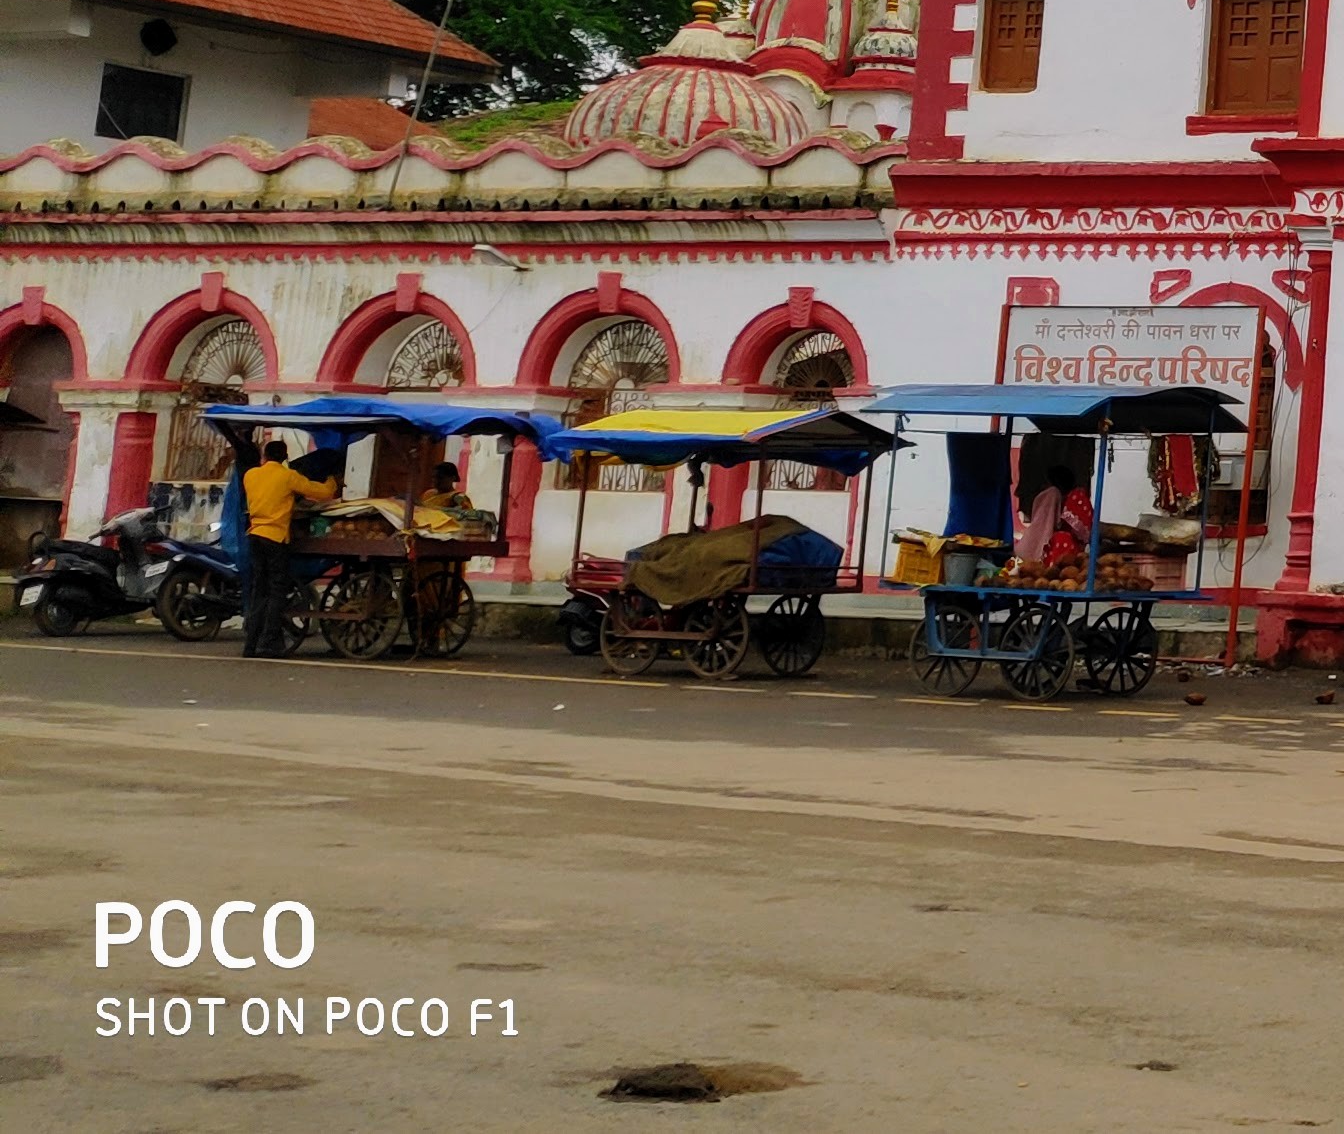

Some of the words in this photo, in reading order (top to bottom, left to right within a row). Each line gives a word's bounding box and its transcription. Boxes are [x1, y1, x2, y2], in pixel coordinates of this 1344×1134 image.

[1056, 319, 1116, 341] दन्तेश्वरी
[1121, 319, 1141, 340] की
[1146, 324, 1184, 341] पावन
[1189, 324, 1216, 341] धरा
[1221, 324, 1242, 341] पर
[1013, 344, 1084, 384] विश्व
